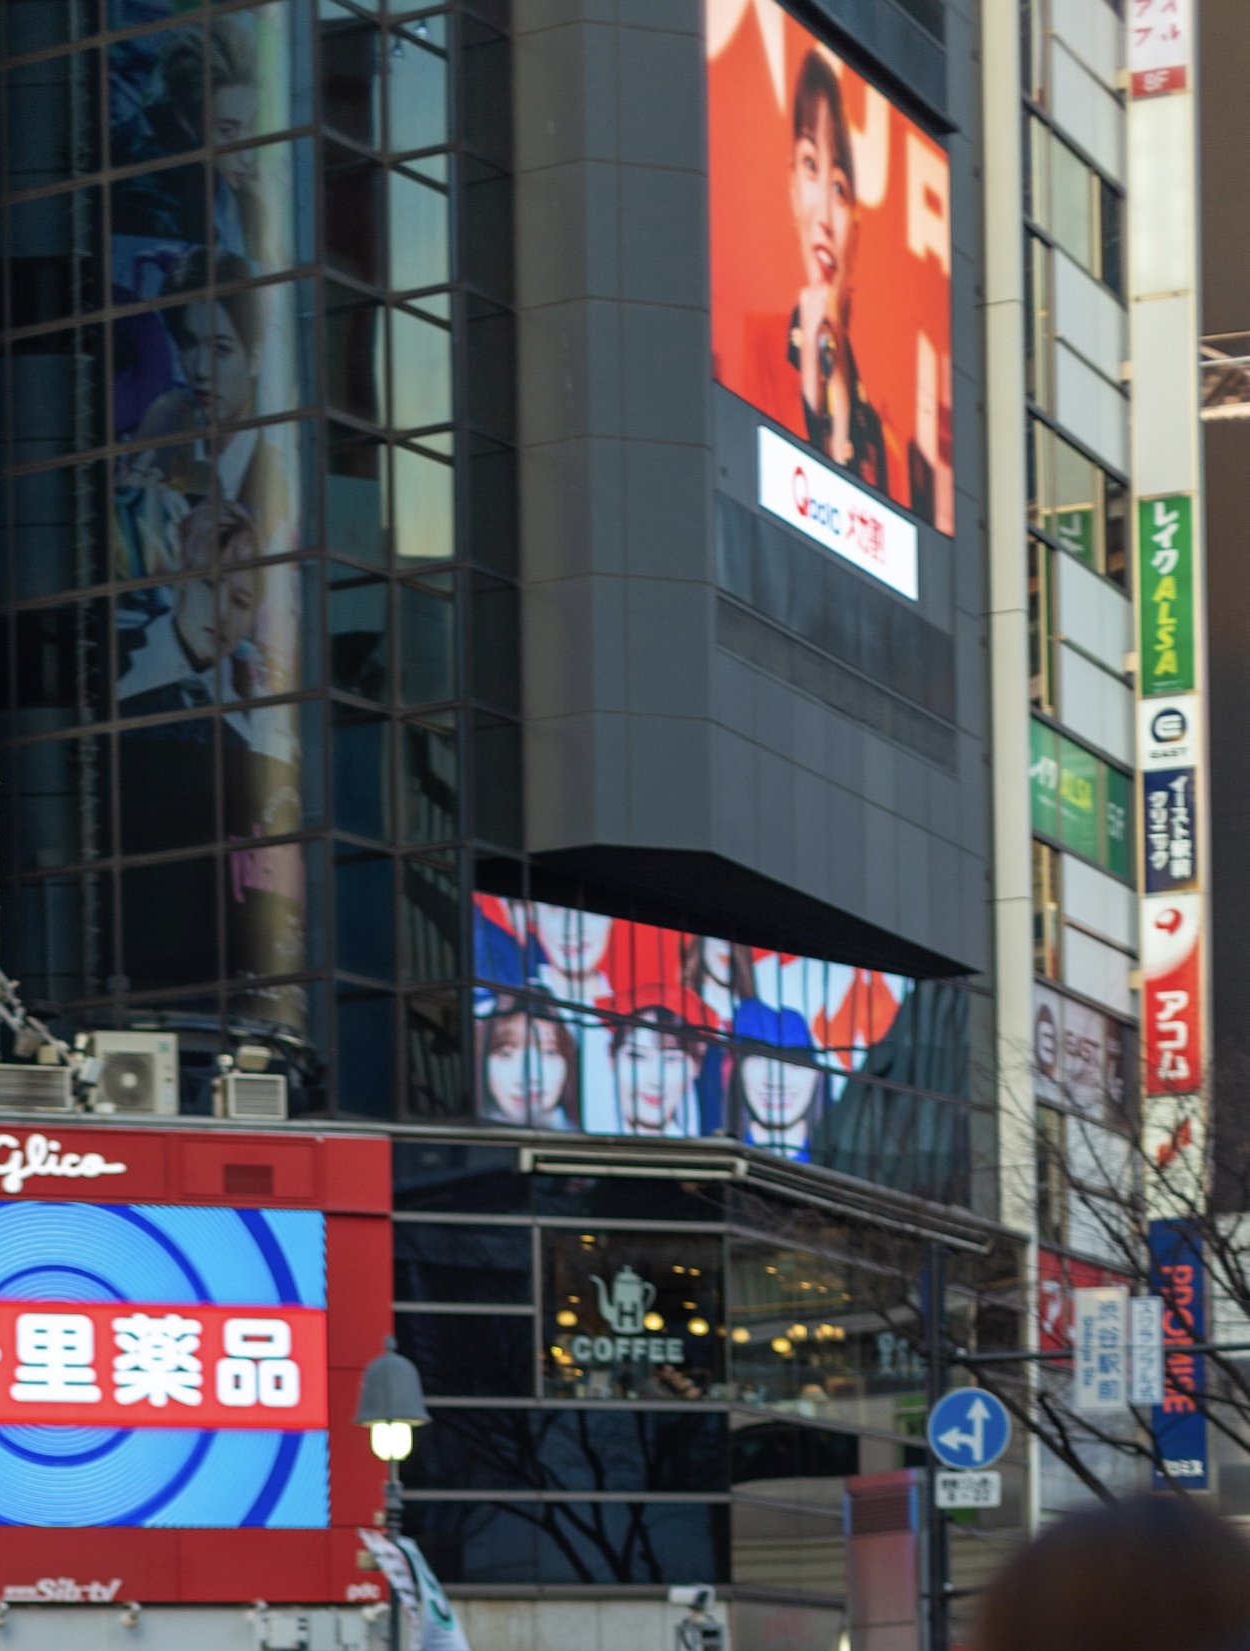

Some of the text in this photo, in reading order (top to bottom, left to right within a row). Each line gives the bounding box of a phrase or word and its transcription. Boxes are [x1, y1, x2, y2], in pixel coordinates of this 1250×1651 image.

[1155, 989, 1191, 1079] アコム
[571, 1335, 686, 1364] COFFEE
